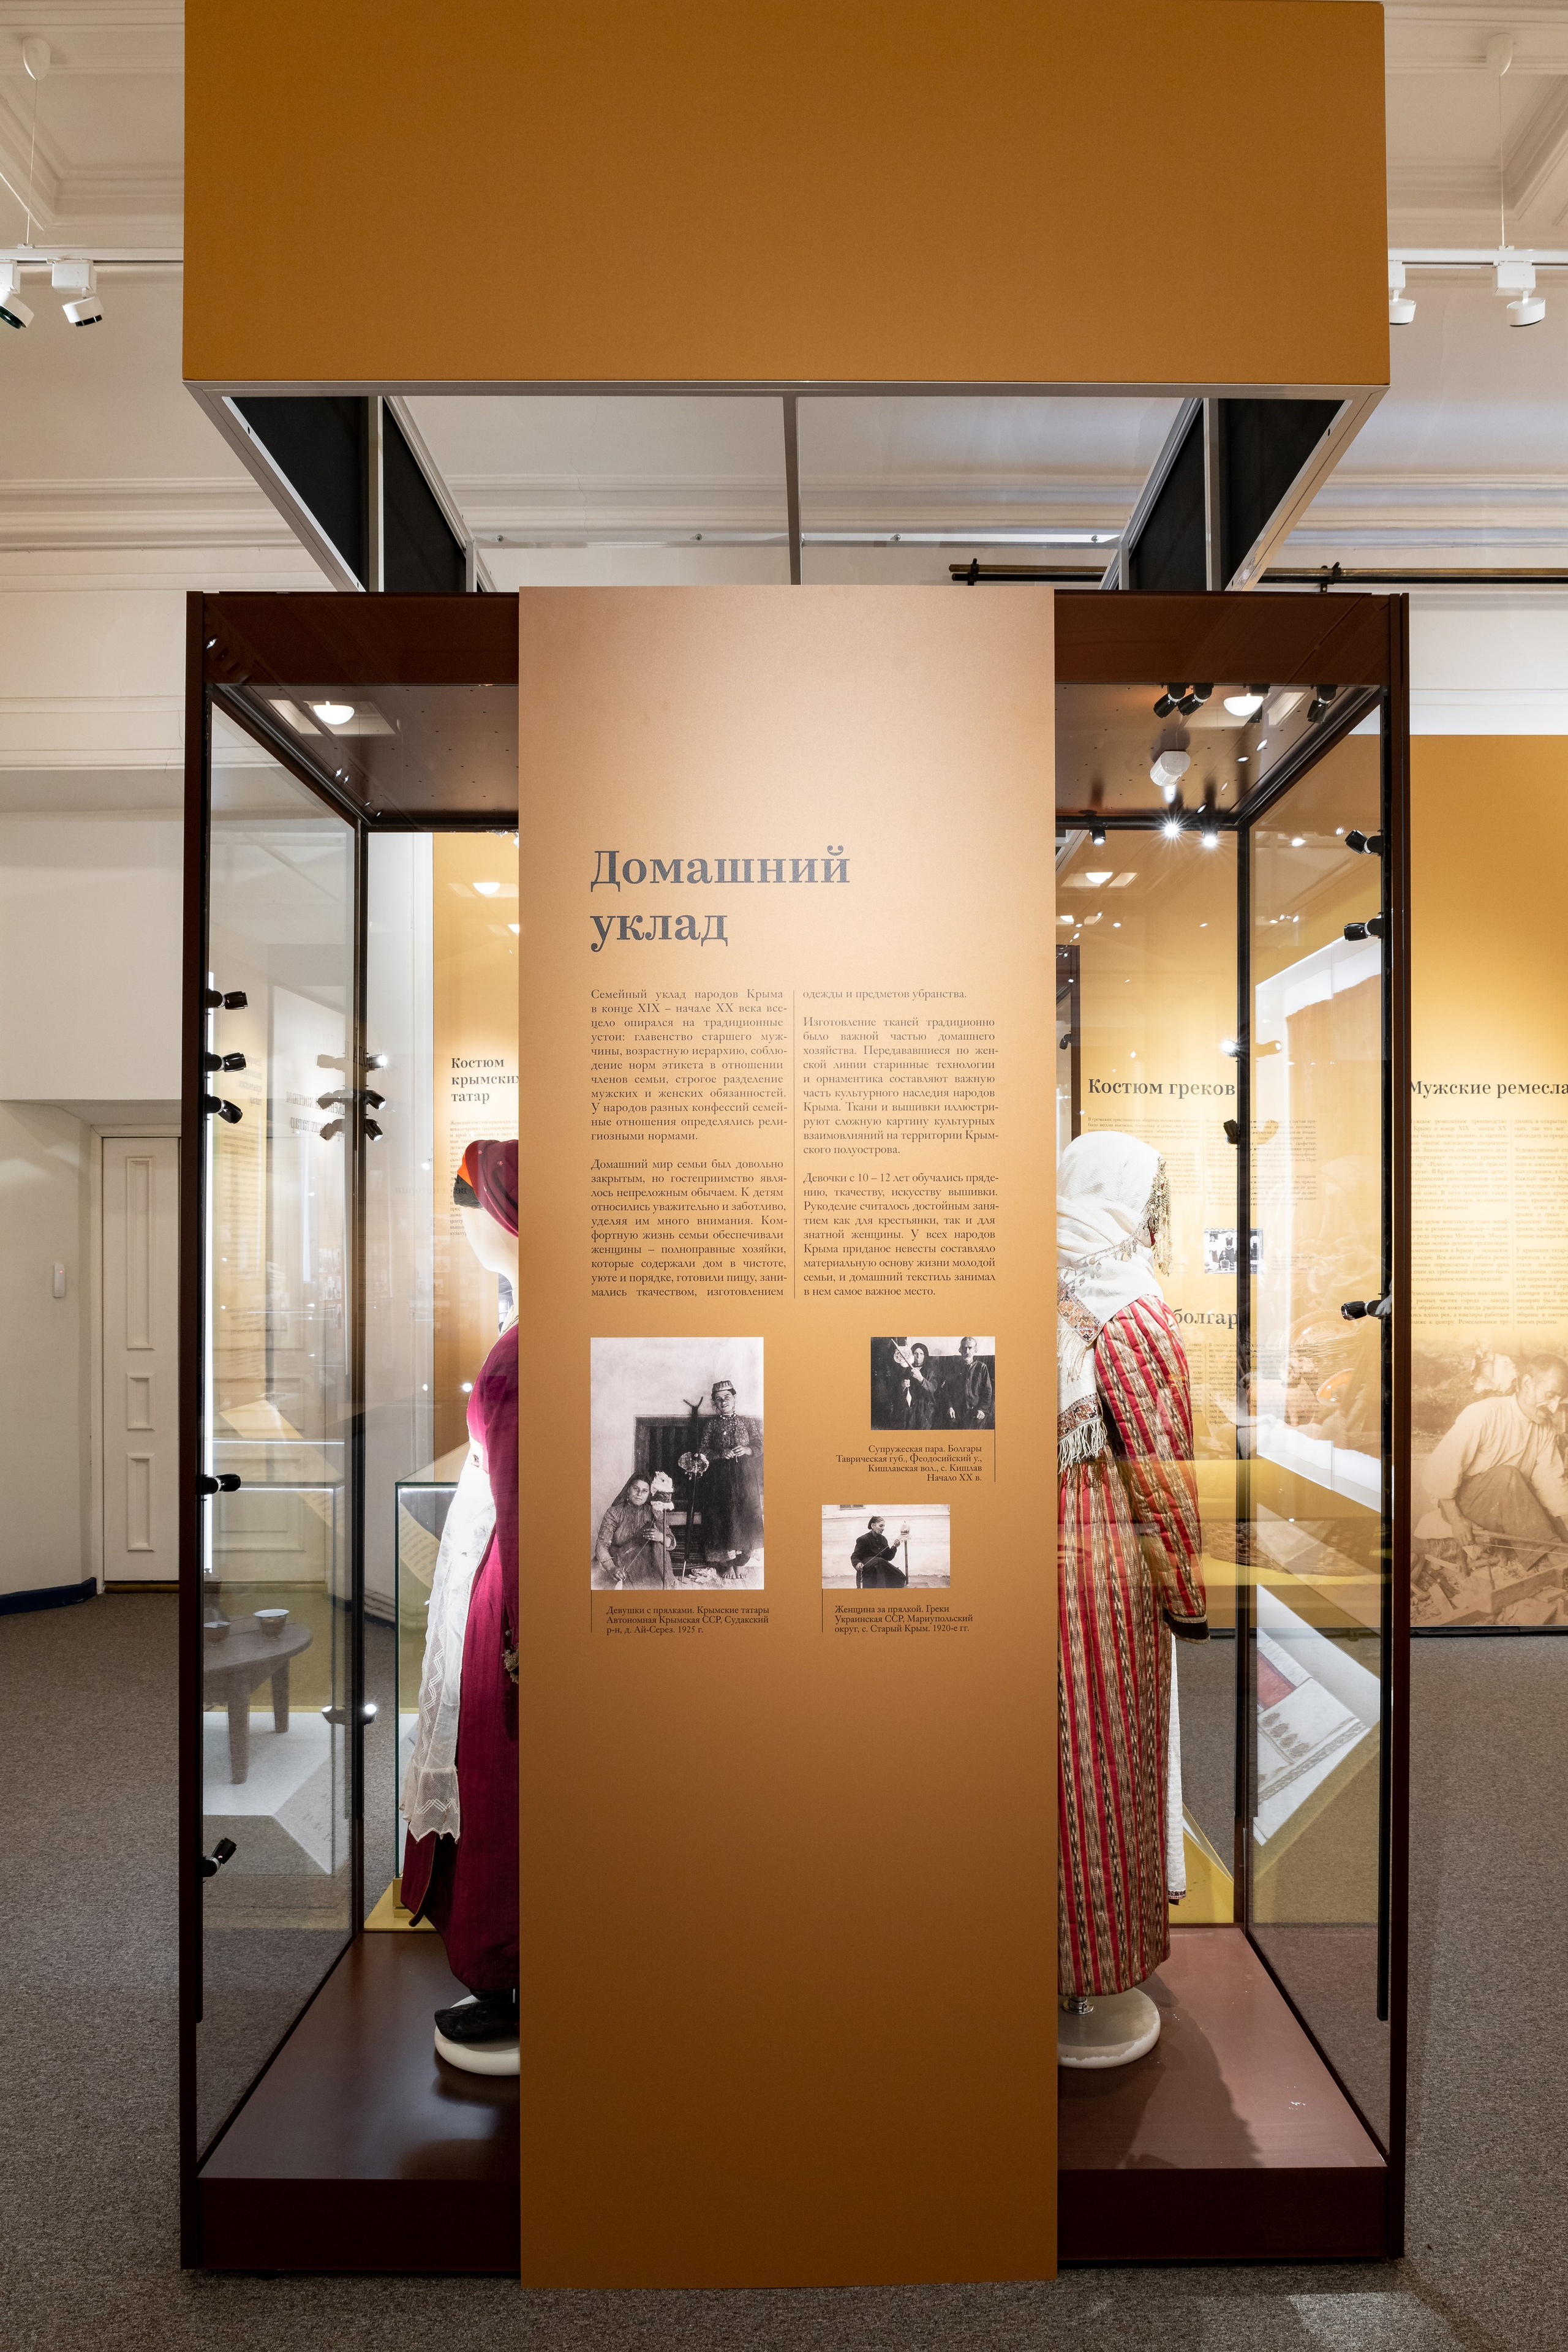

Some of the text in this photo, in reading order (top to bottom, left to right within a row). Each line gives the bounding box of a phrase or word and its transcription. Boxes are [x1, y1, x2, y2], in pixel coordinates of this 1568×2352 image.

[590, 845, 851, 892] Домашний
[589, 914, 728, 952] уклад
[590, 989, 783, 1002] Семейный уклад народов Крыма
[802, 991, 843, 1000] одежды
[855, 991, 910, 1001] предметов
[912, 989, 967, 1001] убранства.
[601, 1006, 633, 1015] конце
[591, 1020, 616, 1029] цело
[624, 1020, 674, 1030] опирался
[703, 1020, 783, 1030] традиционные
[803, 1017, 995, 1030] Изготовление тканей традиционно
[590, 1035, 625, 1044] устои:
[701, 1034, 752, 1044] старшего
[761, 1034, 788, 1044] муж-
[803, 1031, 829, 1041] было
[840, 1031, 879, 1041] важной
[625, 1048, 689, 1058] возрастную
[692, 1048, 748, 1058] иерархию,
[750, 1046, 788, 1055] соблю-
[803, 1045, 857, 1055] хозяйства.
[864, 1045, 950, 1058] Передававшиеся
[451, 1057, 505, 1068] Костюм
[802, 1059, 827, 1069] ской
[873, 1062, 929, 1072] старинные
[1088, 1079, 1236, 1099] Костюм греков
[1411, 1080, 1568, 1099] Мужские ремесла
[451, 1093, 490, 1104] татар
[590, 1159, 648, 1171] Домашний
[652, 1161, 673, 1172] мир
[711, 1159, 732, 1169] был
[735, 1161, 784, 1170] довольно
[590, 1176, 646, 1186] закрытым,
[671, 1175, 754, 1186] гостеприимство
[802, 1172, 847, 1185] Девочки
[858, 1173, 869, 1182] 10
[880, 1172, 891, 1182] 12
[911, 1172, 964, 1185] обучались
[965, 1175, 1000, 1185] пряде-
[616, 1190, 688, 1200] непреложным
[690, 1187, 737, 1197] обычаем.
[741, 1186, 750, 1197] К
[752, 1189, 783, 1198] детям
[834, 1189, 885, 1200] ткачеству,
[891, 1189, 942, 1200] искусству
[652, 1204, 720, 1215] уважительно
[731, 1201, 786, 1212] заботливо,
[804, 1200, 857, 1214] Рукоделие
[912, 1200, 970, 1212] достойным
[868, 1444, 982, 1455] Супружеская пара. Болгары
[835, 1452, 982, 1465] Таврическая губ., Феодосийский у.,
[868, 1464, 918, 1472] Кишлавская
[949, 1463, 982, 1472] Кишлав
[927, 1473, 957, 1482] Начало
[606, 1606, 645, 1616] Девушки
[653, 1608, 695, 1616] прялками.
[696, 1605, 739, 1616] Крымские
[740, 1608, 770, 1616] татары
[834, 1605, 876, 1615] Женщина
[887, 1604, 924, 1615] прялкой.
[925, 1604, 949, 1615] Греки
[658, 1616, 700, 1626] Крымская
[702, 1616, 723, 1624] ССР,
[724, 1616, 769, 1626] Судакский
[834, 1613, 973, 1626] Украинская ССР, Мариупольский
[606, 1627, 622, 1636] р-н,
[633, 1625, 676, 1636] Ай-Серез.
[834, 1627, 860, 1635] округ,
[870, 1624, 902, 1635] Старый
[904, 1624, 930, 1635] Крым.
[933, 1624, 958, 1632] 1920-е
